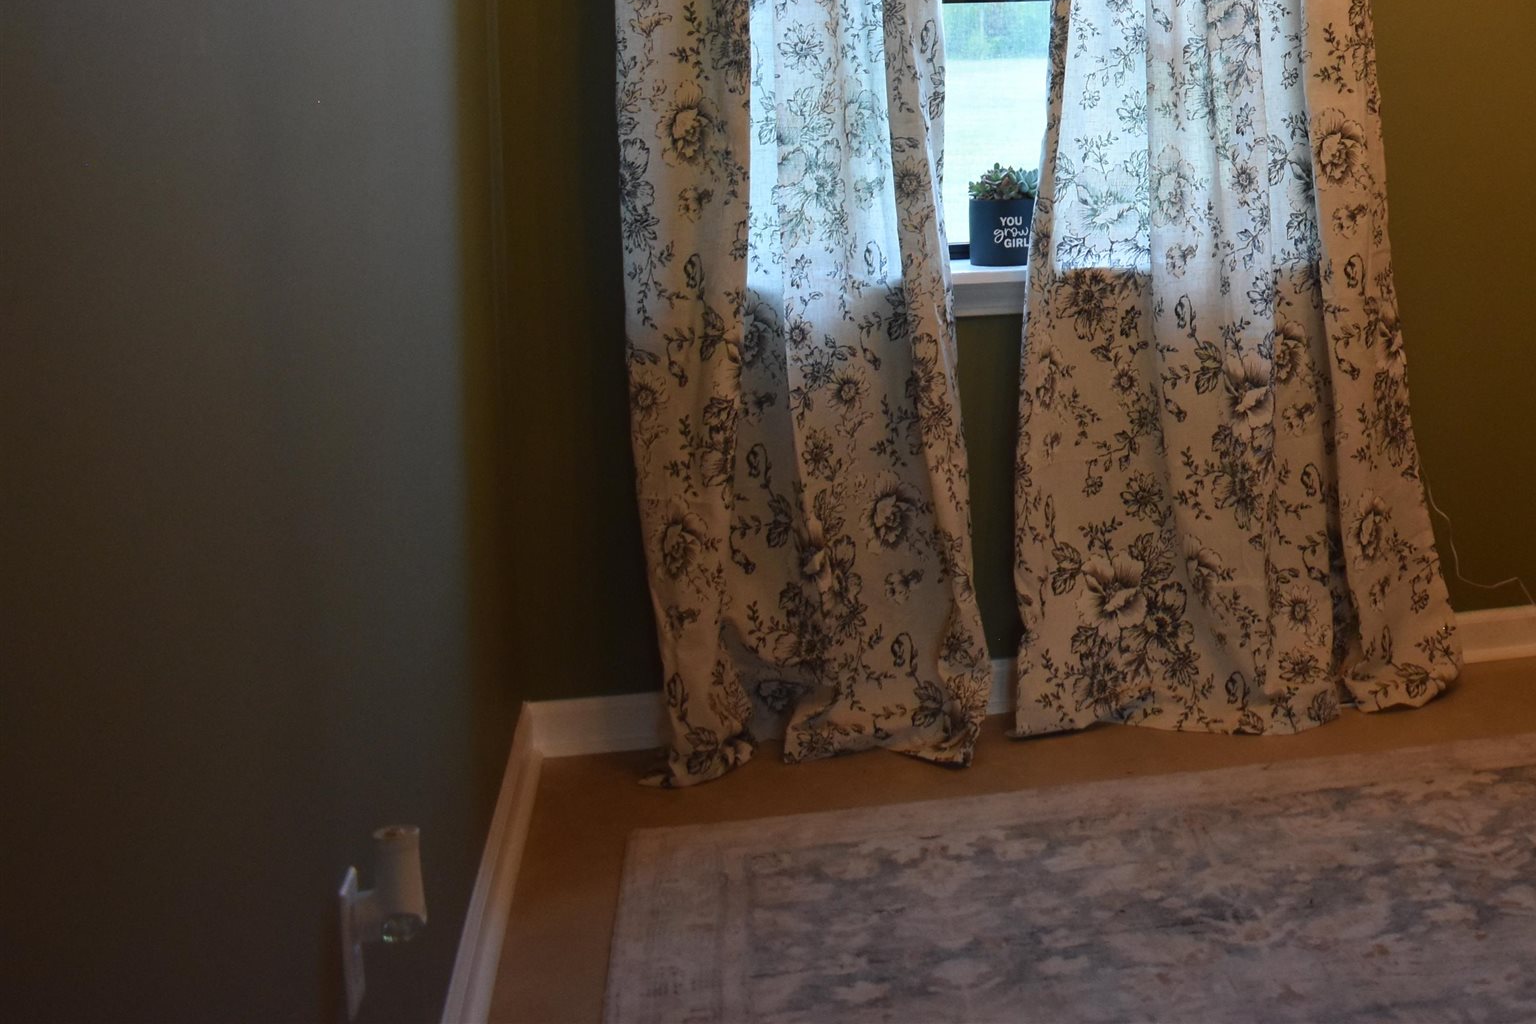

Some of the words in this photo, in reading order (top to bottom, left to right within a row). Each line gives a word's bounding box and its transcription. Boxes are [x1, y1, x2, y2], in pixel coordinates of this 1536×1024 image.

[1000, 216, 1022, 226] YOU
[993, 227, 1029, 244] grow
[1004, 238, 1030, 248] GIRL
